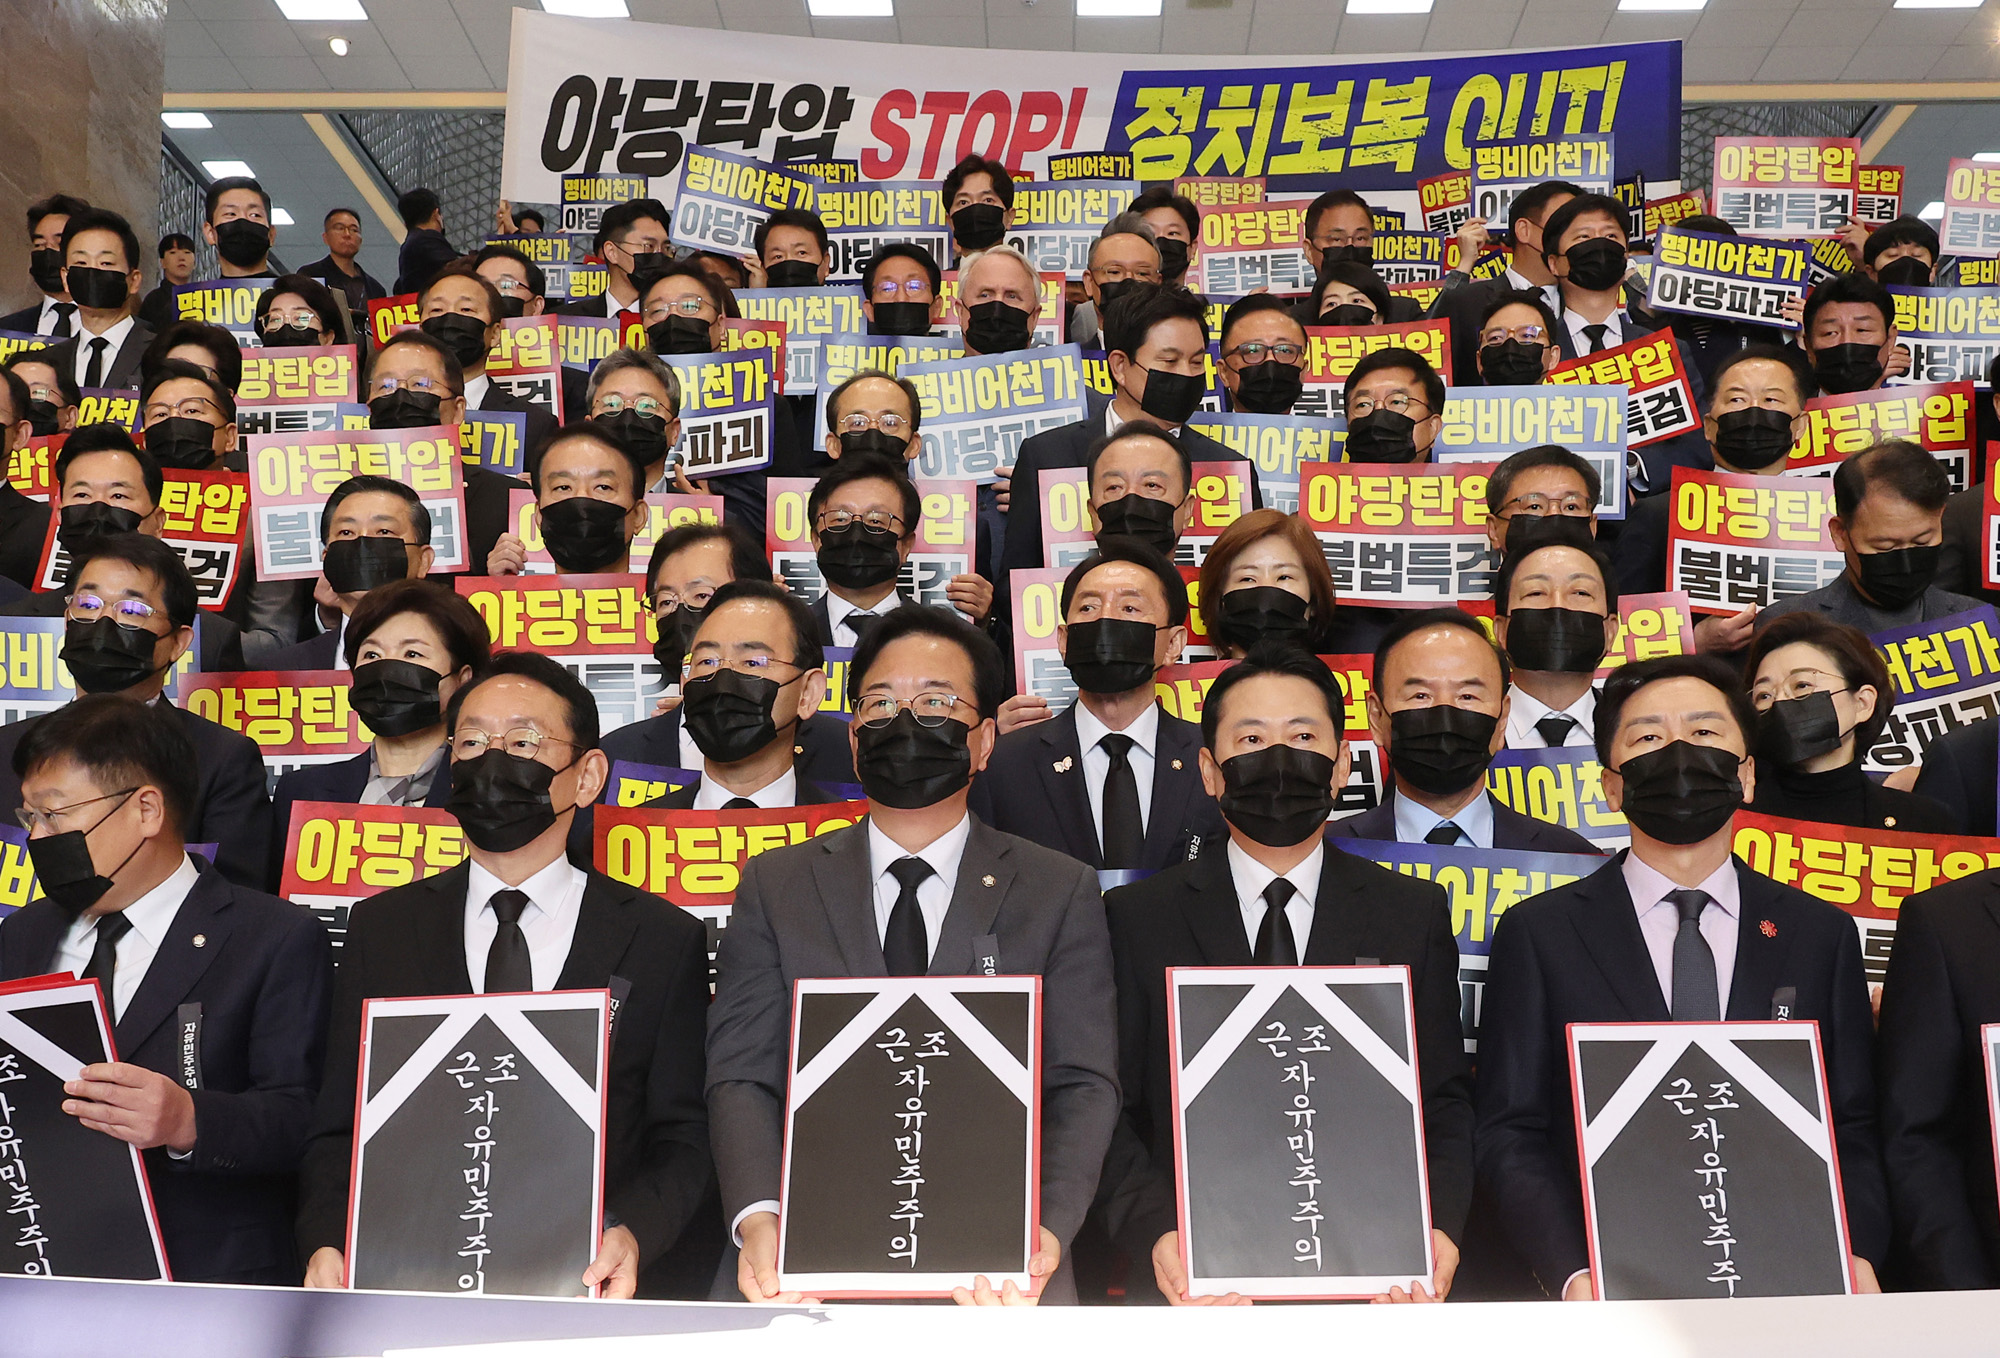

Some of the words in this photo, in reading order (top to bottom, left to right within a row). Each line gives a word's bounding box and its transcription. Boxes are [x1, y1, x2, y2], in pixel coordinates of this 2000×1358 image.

[541, 74, 855, 177] 야당탄압
[860, 86, 1088, 179] STOP!
[1124, 76, 1431, 180] 정치보복
[688, 154, 814, 212] 명비어천가
[1050, 155, 1132, 181] 명비어천가
[1475, 141, 1610, 180] 명비어천가
[1720, 146, 1856, 183] 야당탄압
[1859, 170, 1901, 192] 탄압
[564, 177, 647, 202] 명비어천가
[818, 189, 945, 228] 명비어천가
[1722, 192, 1849, 230] 불법특검
[1202, 208, 1308, 247] 야당탄
[1660, 233, 1805, 281] 명비어천가
[740, 295, 862, 335] 비어천가
[1656, 273, 1796, 319] 야당파괴
[240, 355, 351, 400] 당탄압
[906, 354, 1078, 418] 명비어천가
[1441, 396, 1622, 445] 명비어천가
[1677, 482, 1836, 543] 야당탄
[467, 587, 659, 648] 야당탄
[188, 685, 375, 746] 야당탄
[183, 1021, 198, 1089] 자유민주주의
[888, 1064, 931, 1269] 자유민주주의
[1281, 1059, 1325, 1272] 자유민주주의
[1688, 1116, 1743, 1299] 자유민주주
